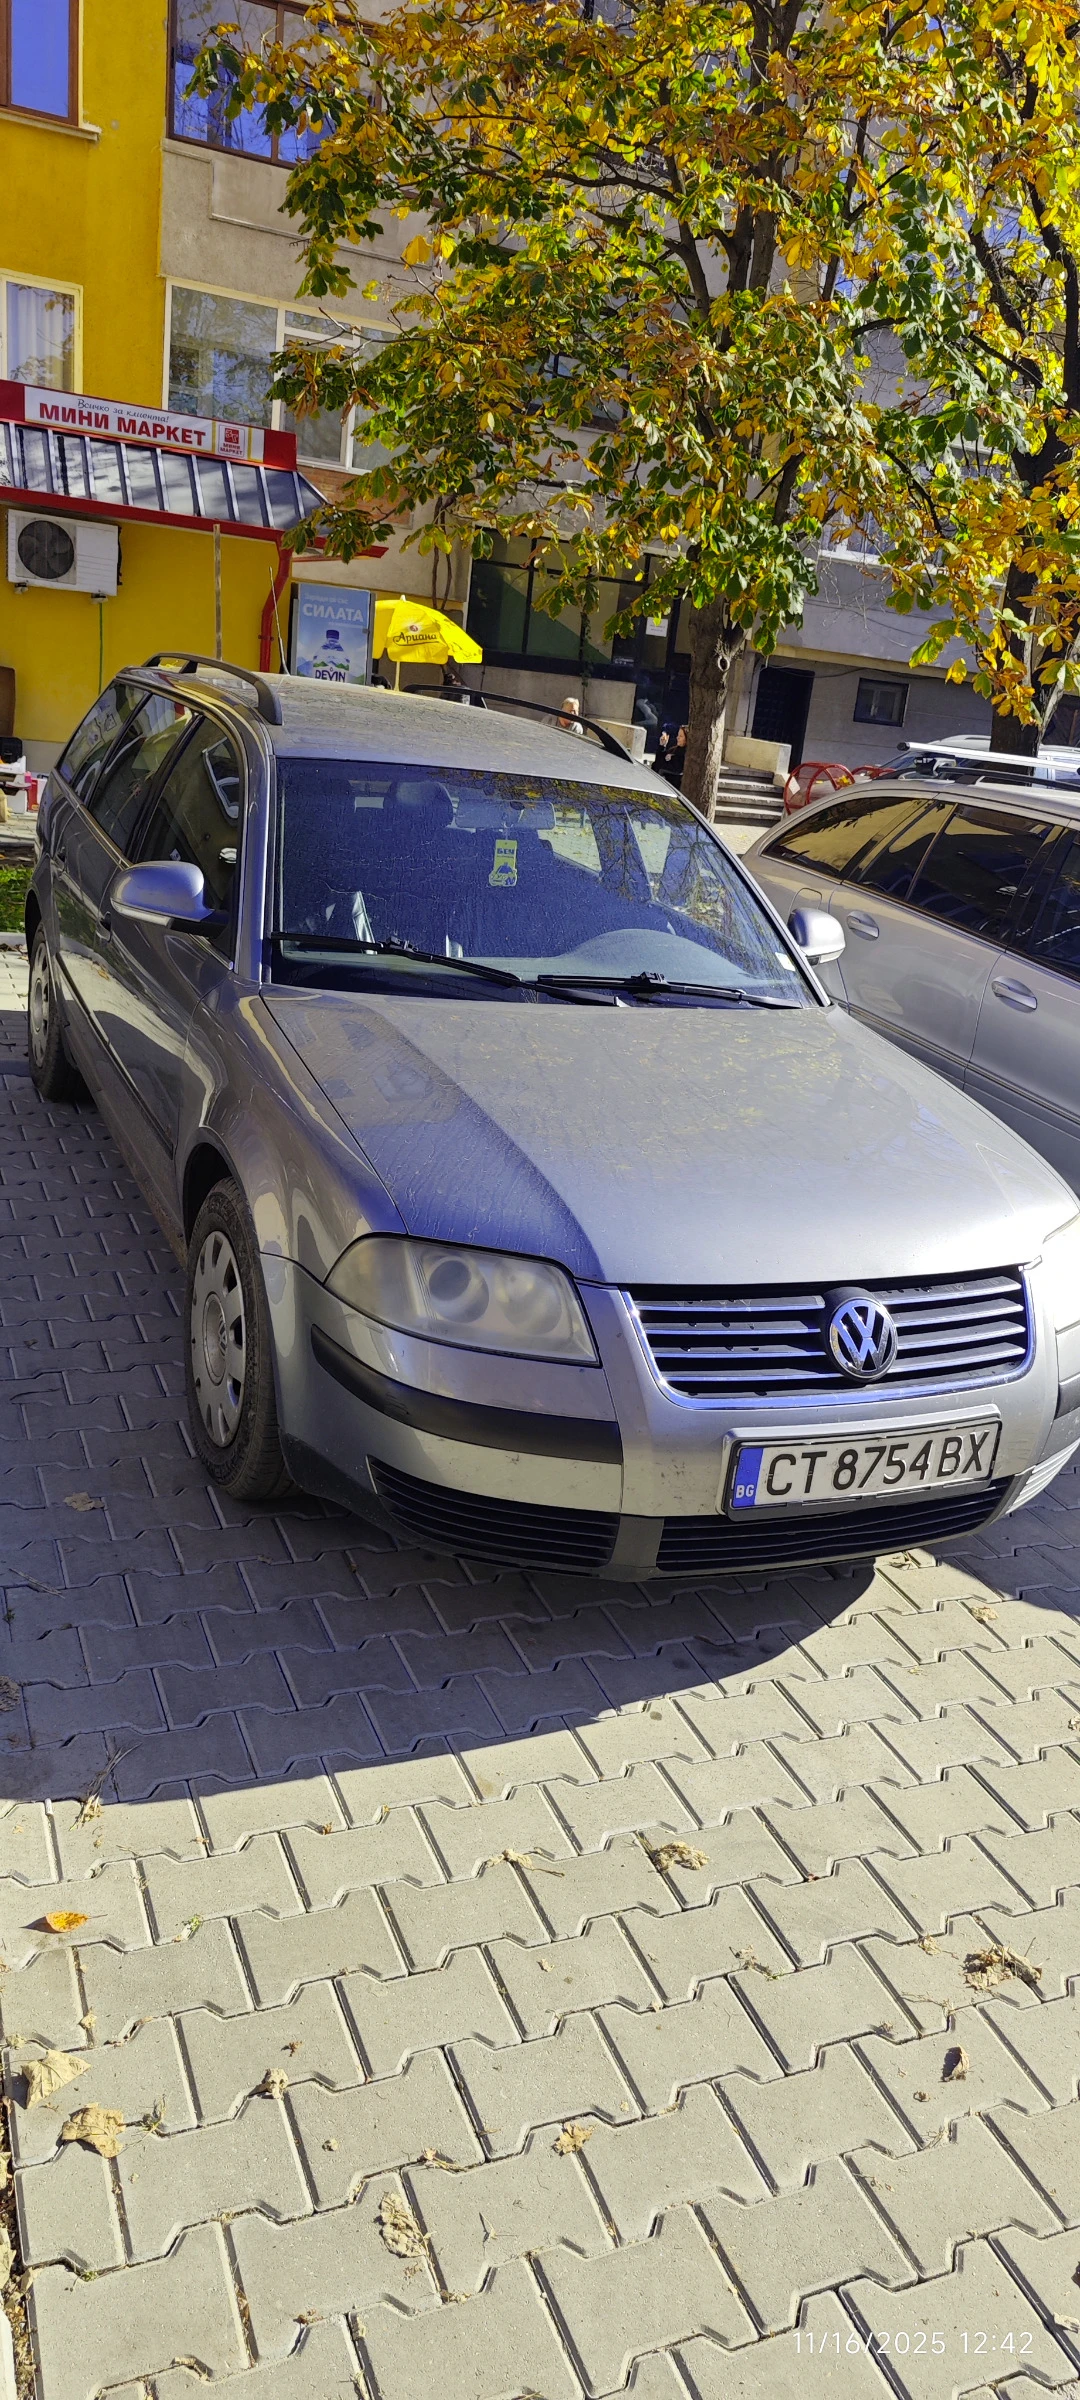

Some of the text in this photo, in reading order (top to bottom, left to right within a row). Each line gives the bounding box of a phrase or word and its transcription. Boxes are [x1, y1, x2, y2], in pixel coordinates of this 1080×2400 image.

[77, 398, 170, 423] Всичко за клиента!
[39, 402, 206, 446] МИНИ МАРКЕТ
[303, 603, 364, 622] СИЛАТА
[392, 631, 438, 646] Ариана
[315, 669, 346, 683] DEVIN
[766, 1430, 991, 1496] CT 8754 BX
[735, 1484, 755, 1498] BG
